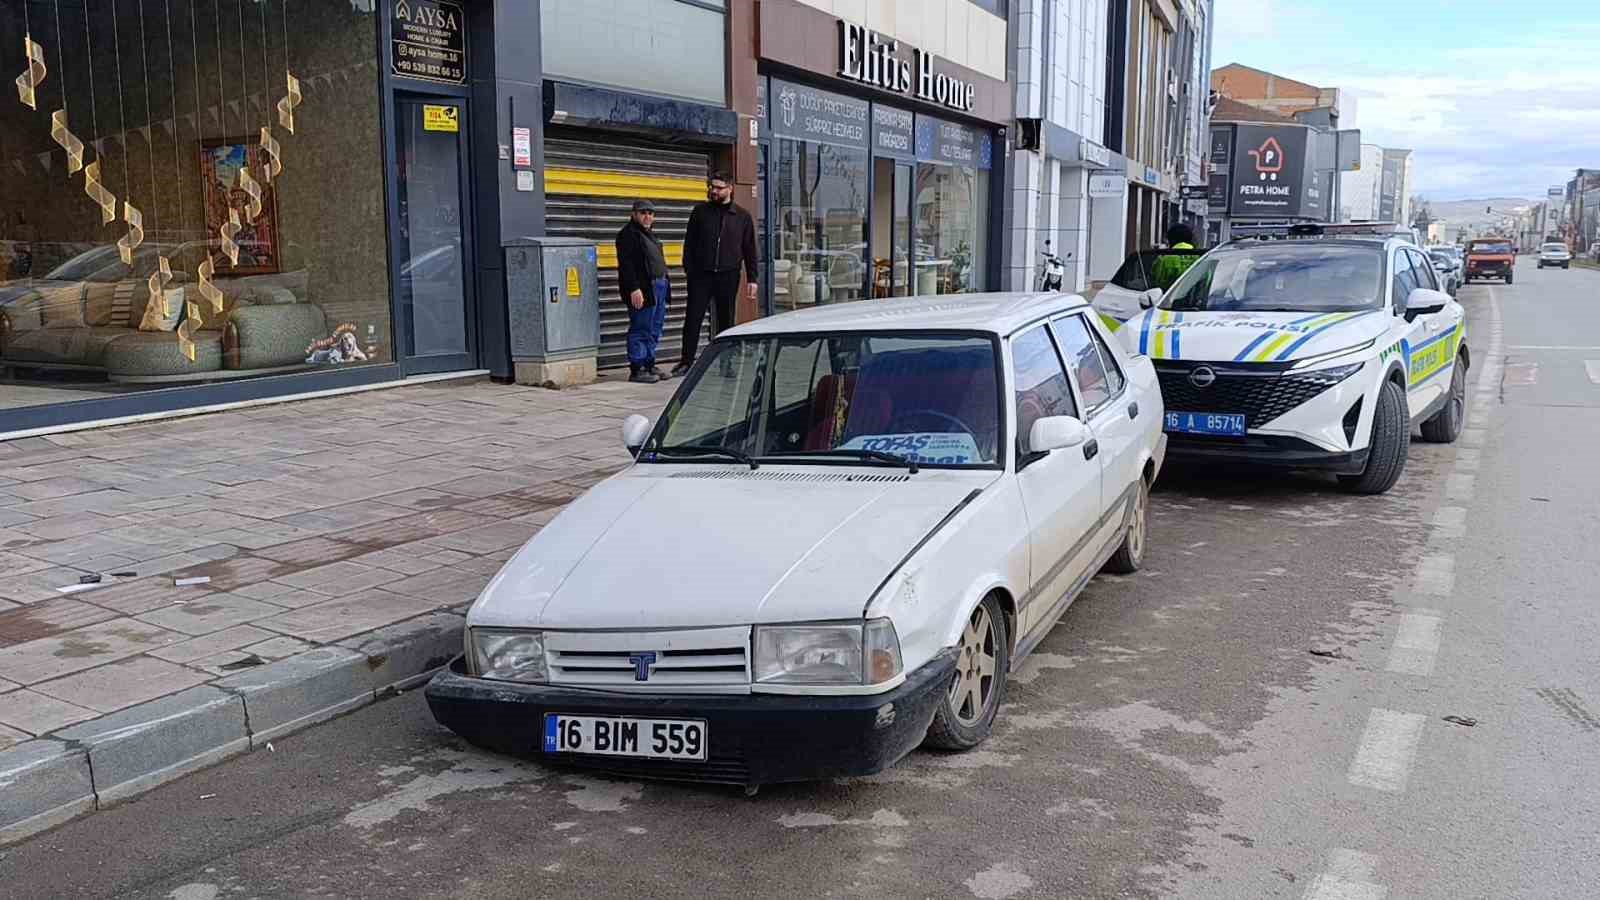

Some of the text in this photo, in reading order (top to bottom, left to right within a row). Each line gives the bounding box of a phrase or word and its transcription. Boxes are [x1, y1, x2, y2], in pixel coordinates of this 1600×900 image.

[415, 6, 457, 30] AYSA
[407, 33, 424, 41] HOME
[398, 60, 411, 71] +90
[451, 68, 461, 78] 15
[841, 20, 975, 111] Elitis Home
[1265, 151, 1274, 164] P
[1240, 185, 1289, 196] PETRA HOME
[1166, 413, 1242, 430] 16 A 85714
[558, 719, 701, 755] 16 BIM 559
